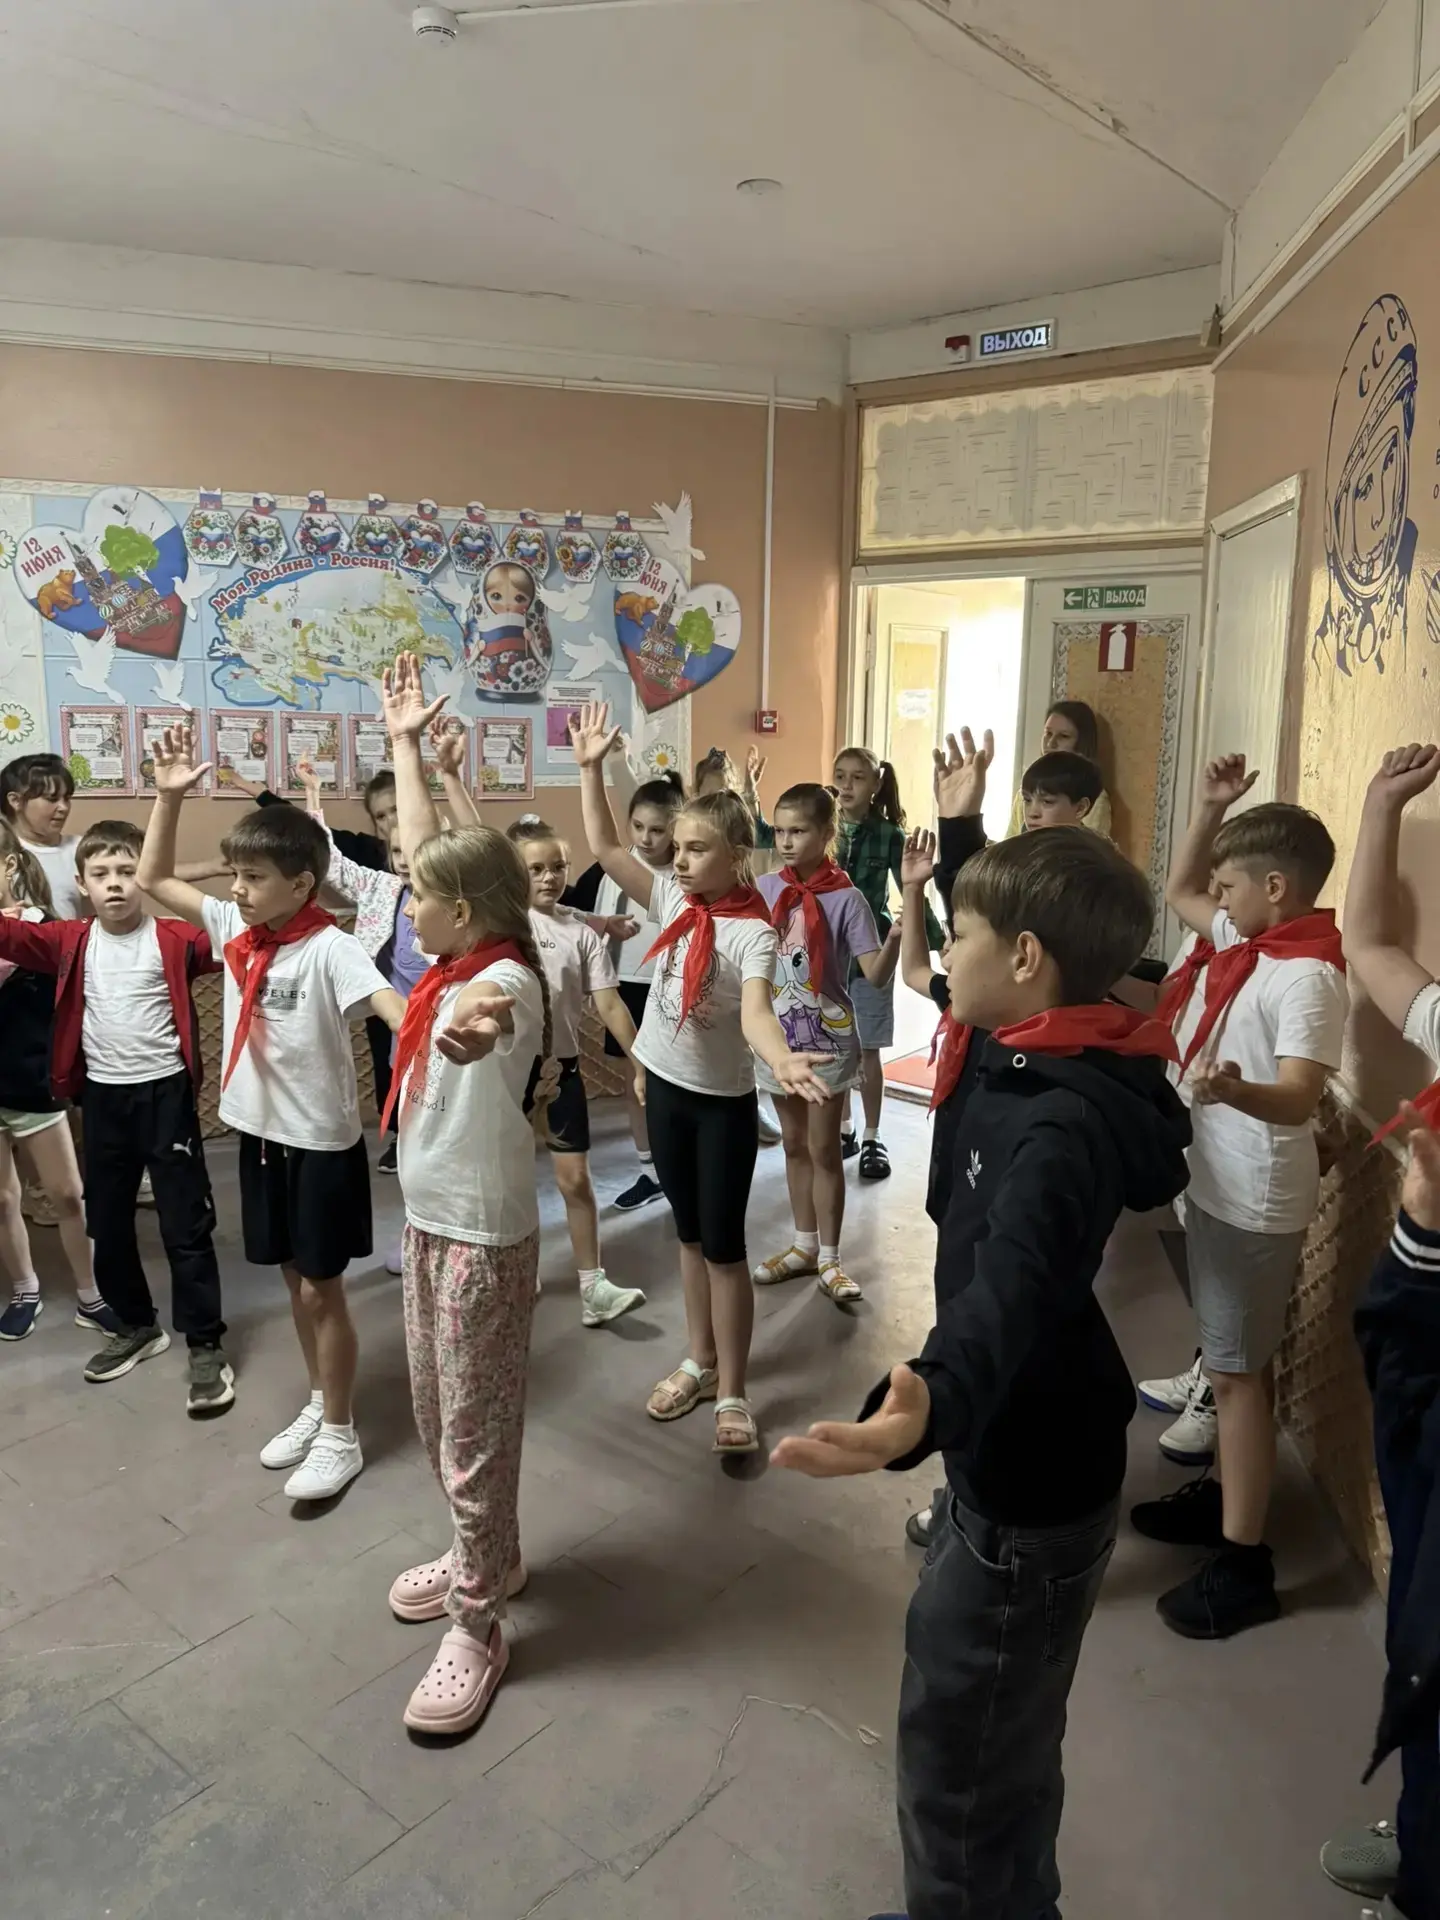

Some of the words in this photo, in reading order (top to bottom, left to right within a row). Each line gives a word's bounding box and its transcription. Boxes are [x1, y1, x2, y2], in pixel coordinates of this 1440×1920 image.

[983, 326, 1047, 353] ВЫХОД
[23, 536, 43, 555] 12
[21, 545, 66, 577] ИЮНЯ
[649, 559, 661, 576] 12
[212, 581, 248, 611] Моя
[249, 557, 314, 586] Родина
[331, 553, 396, 571] Россия!
[640, 572, 667, 595] ЮНЯ
[1106, 589, 1145, 605] ВЫХОД
[540, 938, 556, 949] alo
